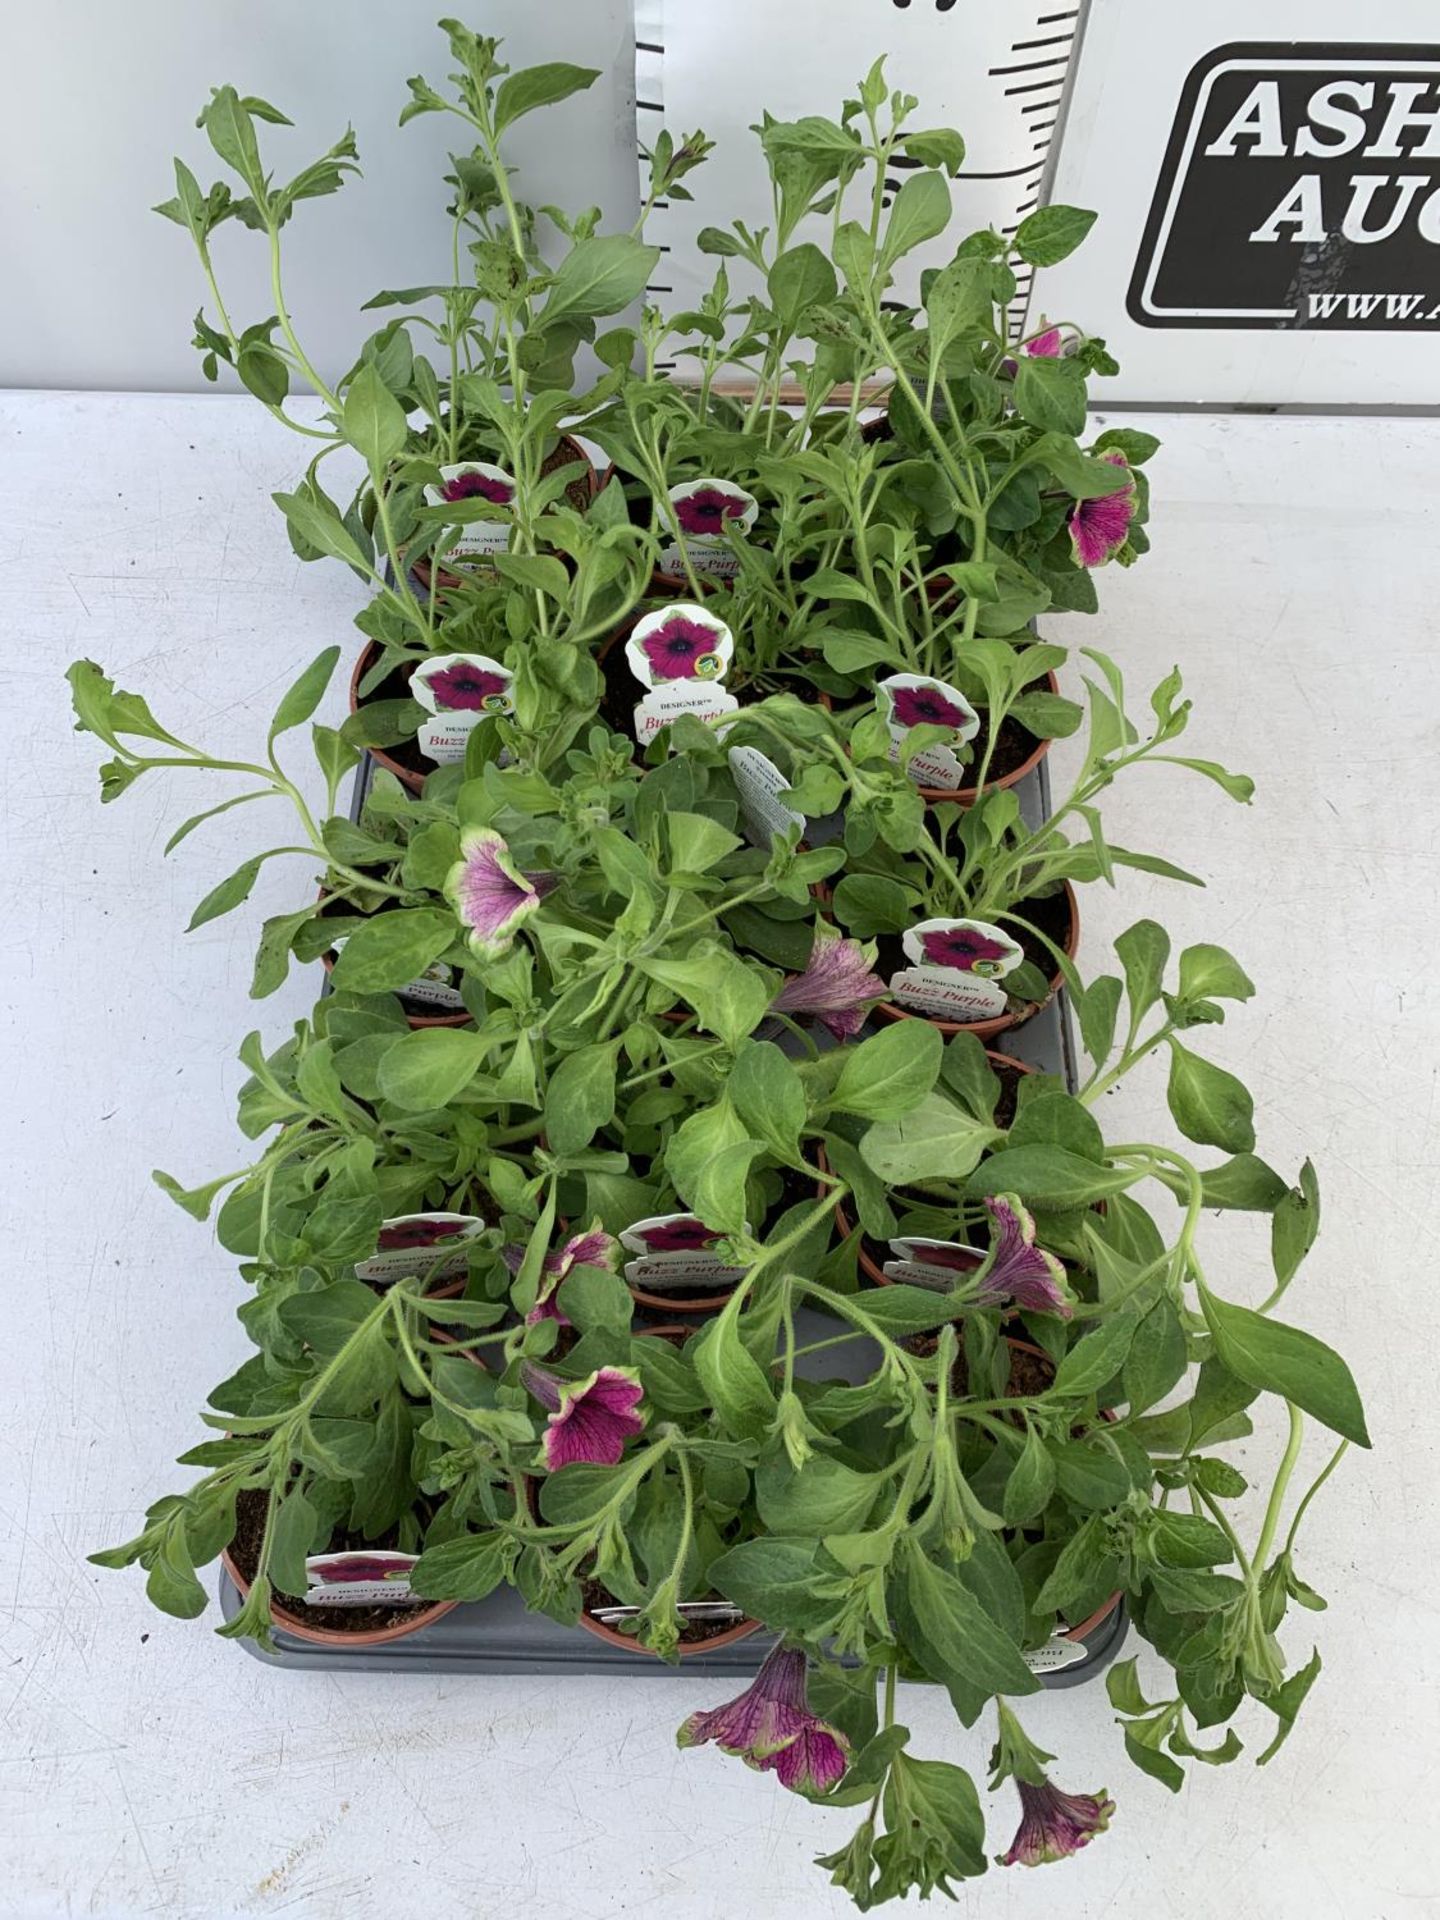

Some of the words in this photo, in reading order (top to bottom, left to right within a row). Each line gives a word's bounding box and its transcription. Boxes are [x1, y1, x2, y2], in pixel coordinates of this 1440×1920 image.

[429, 735, 465, 746] Buzz
[899, 982, 940, 996] Buzz
[943, 991, 996, 1008] Purple
